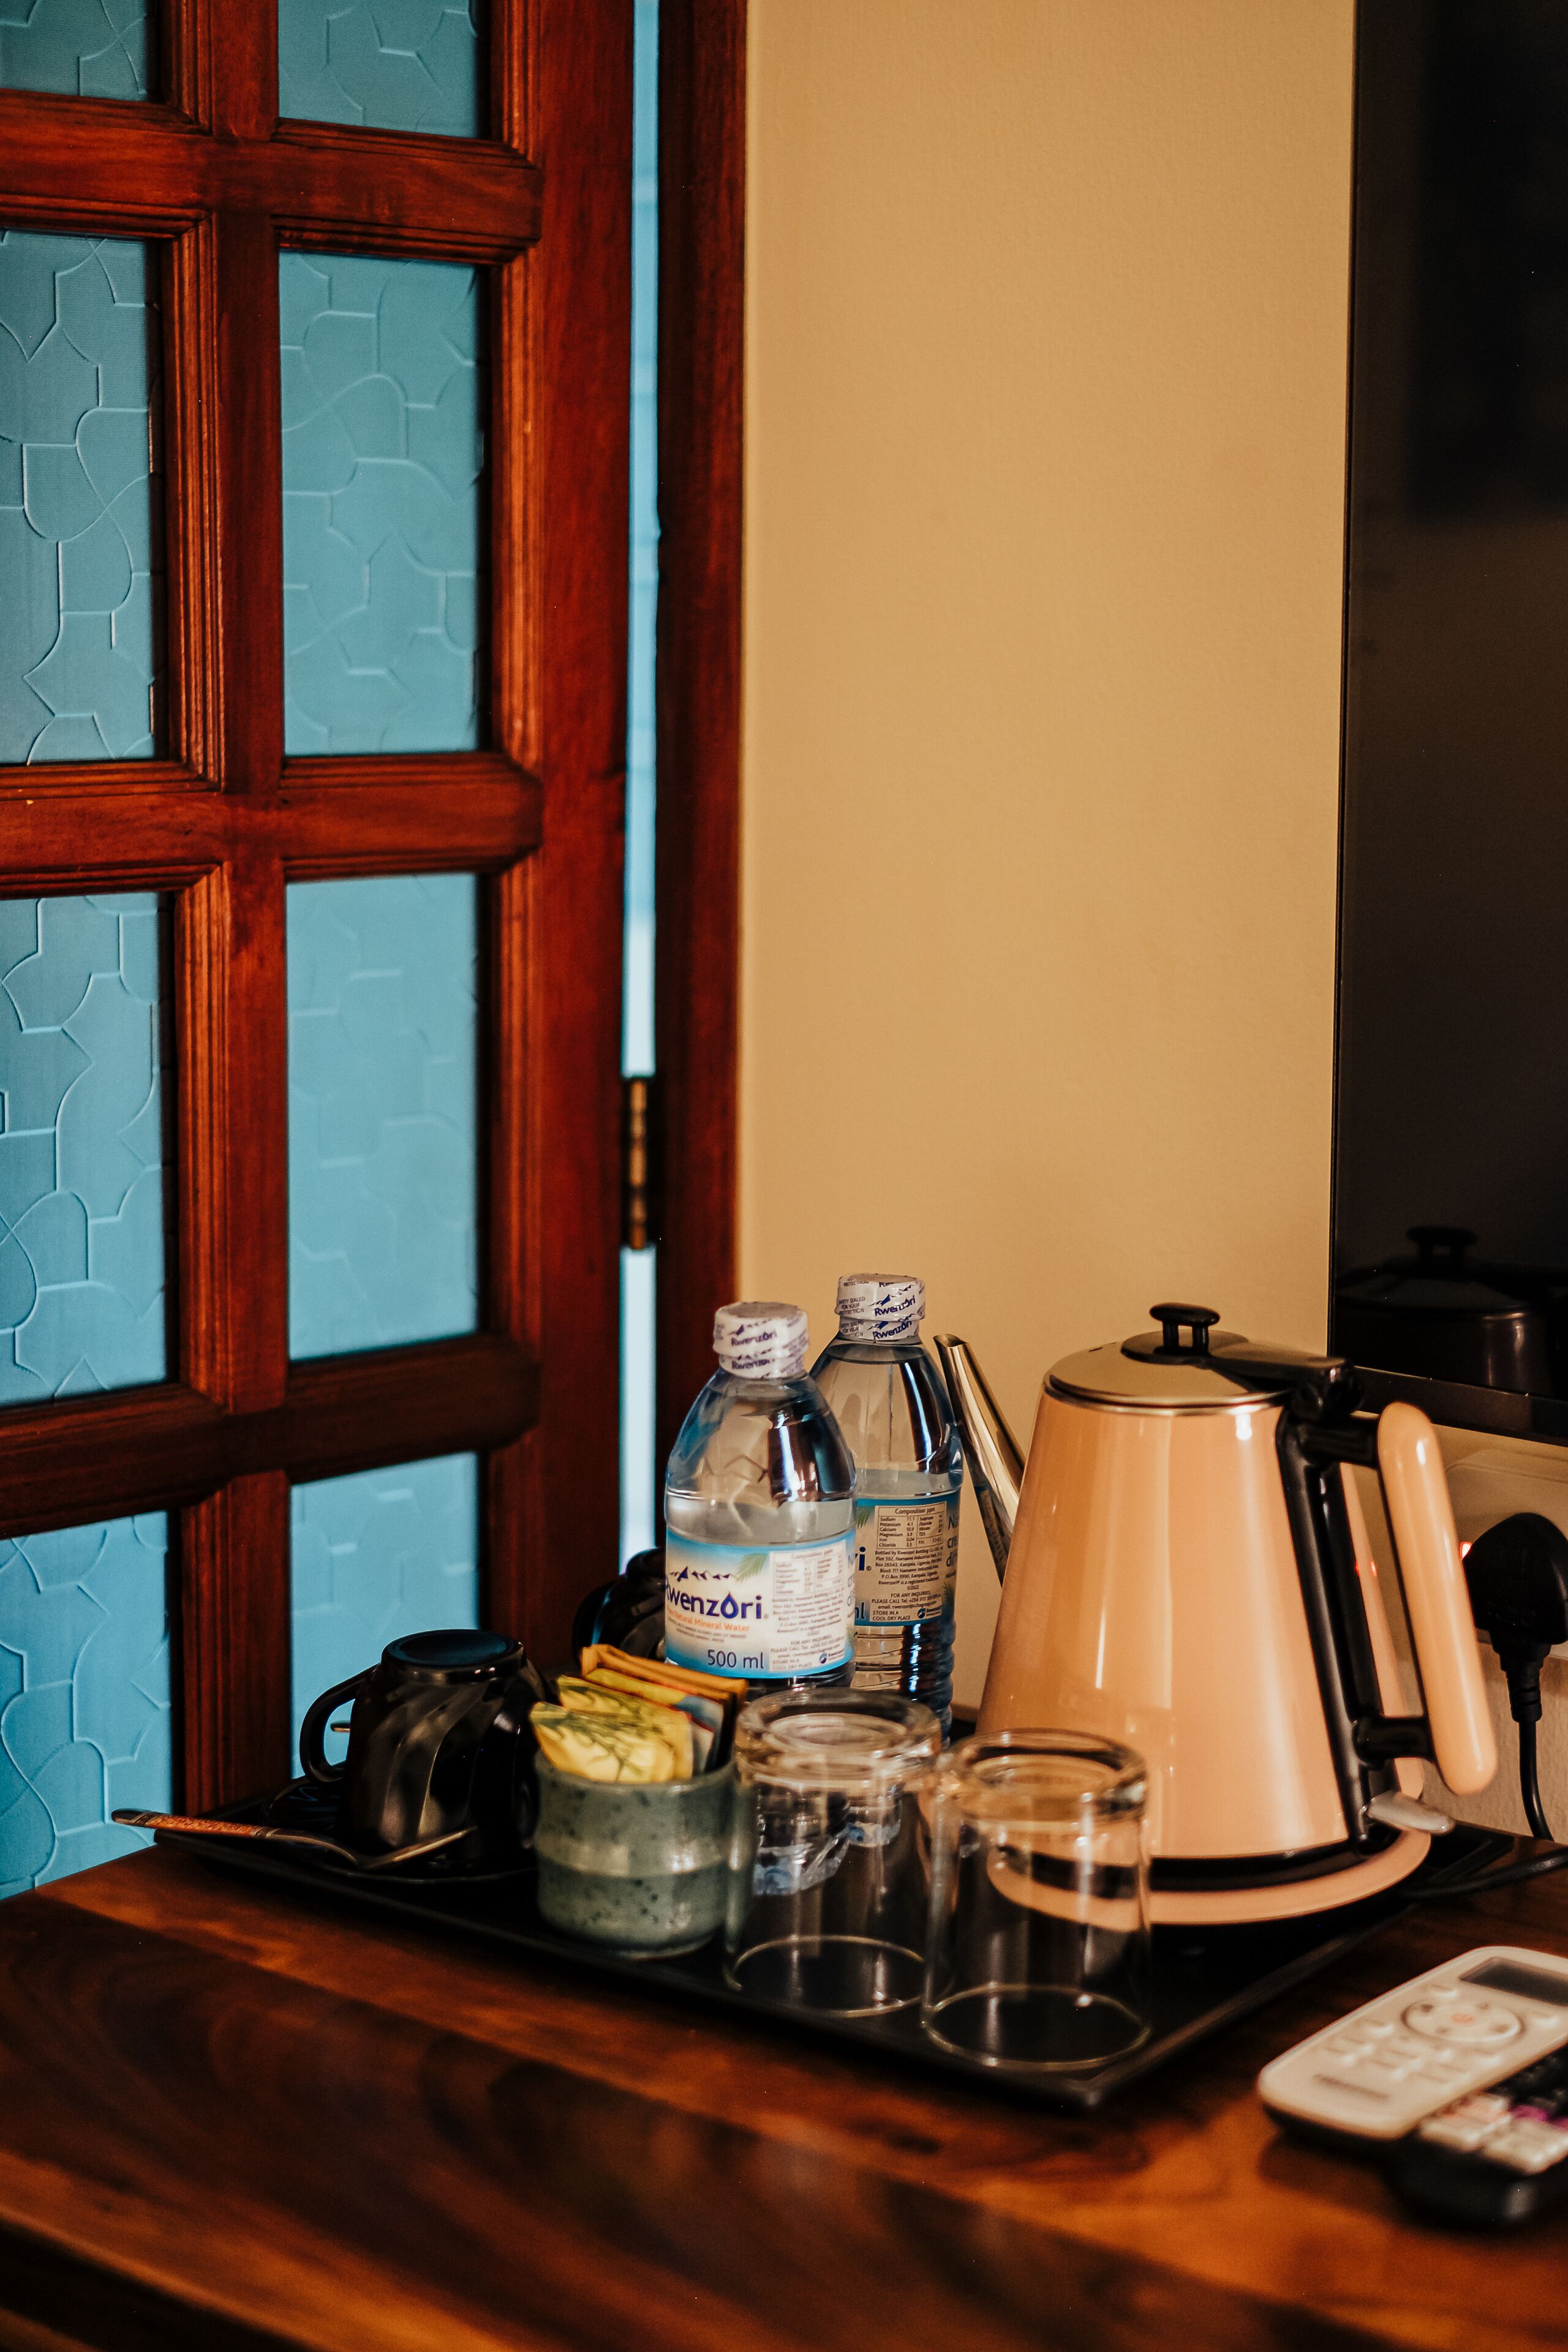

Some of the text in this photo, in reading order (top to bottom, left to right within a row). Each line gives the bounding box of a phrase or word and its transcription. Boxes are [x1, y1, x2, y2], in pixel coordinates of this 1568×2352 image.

[874, 1295, 916, 1316] Rwenzori
[873, 1320, 912, 1341] Rwenzori
[695, 1617, 722, 1630] Mineral
[724, 1623, 750, 1632] Water
[707, 1648, 764, 1669] 500 ml
